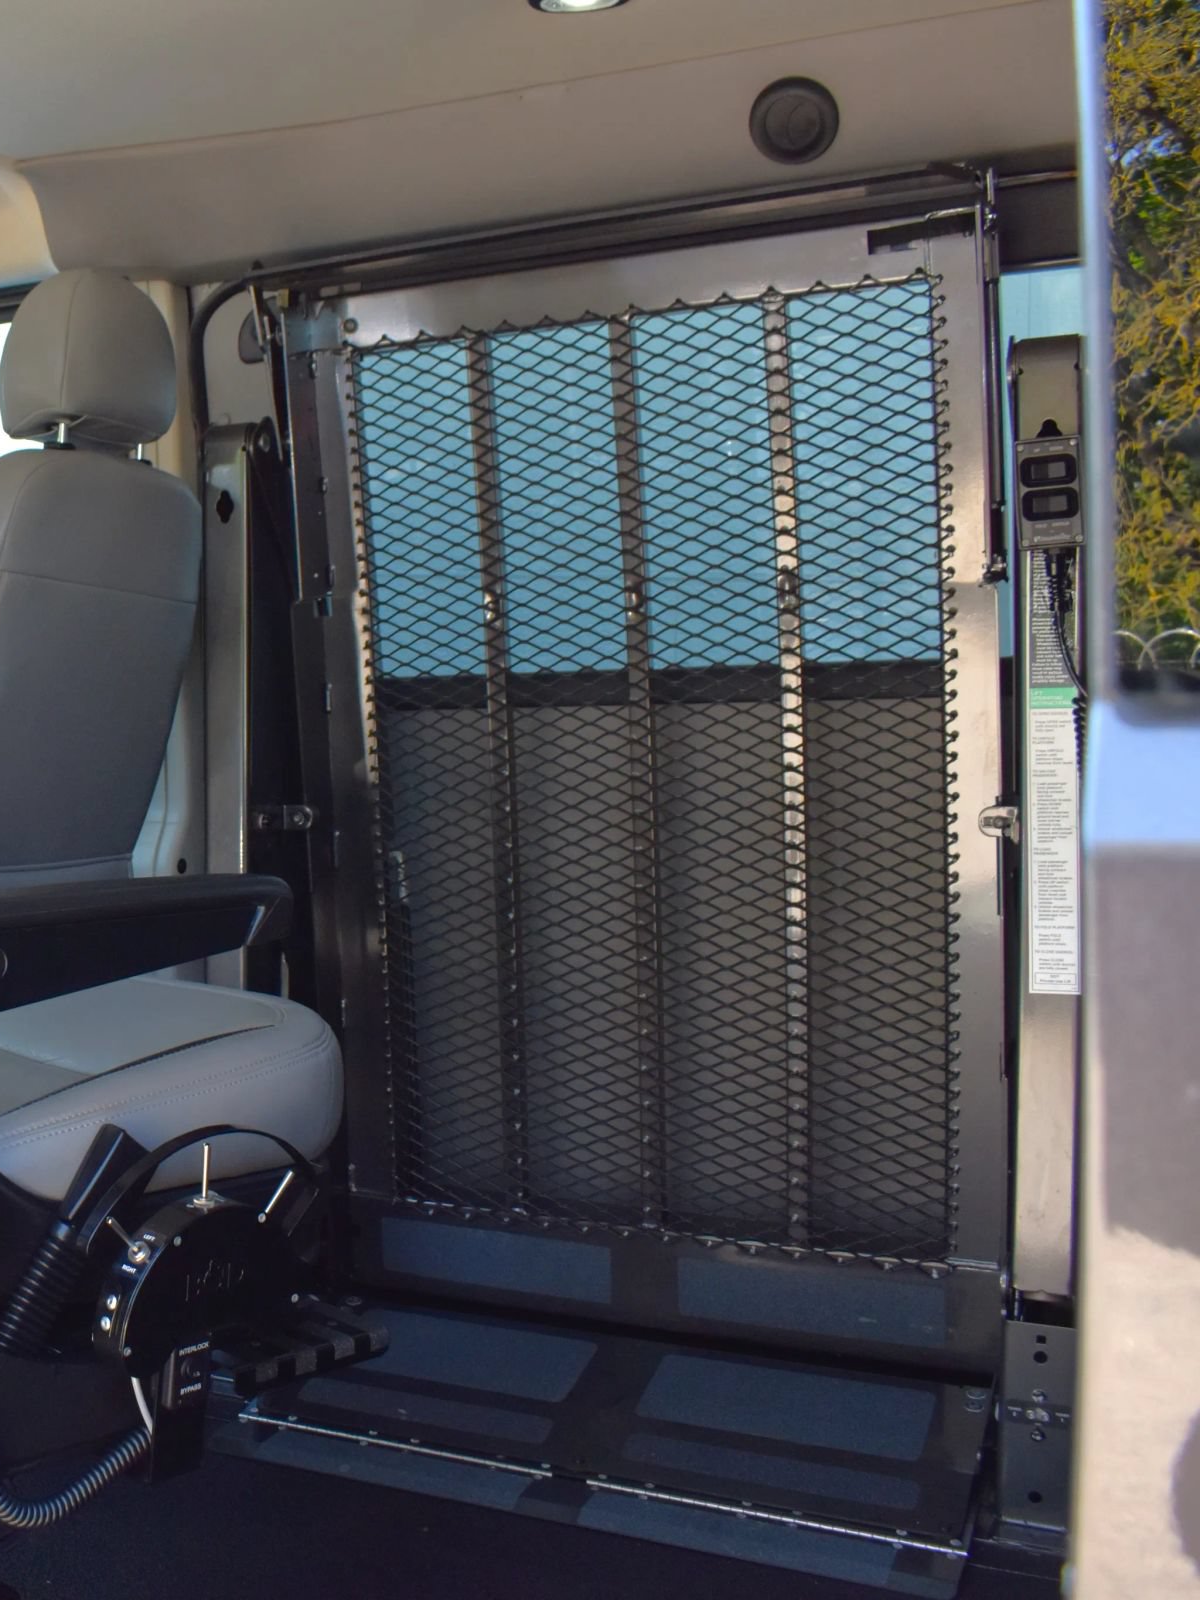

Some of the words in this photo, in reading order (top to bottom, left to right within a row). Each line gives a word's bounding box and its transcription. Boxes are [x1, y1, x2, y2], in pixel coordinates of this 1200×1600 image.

[143, 1233, 156, 1242] LEFT
[121, 1263, 137, 1274] RIGHT
[178, 1340, 209, 1356] INTERLOCK
[179, 1382, 202, 1396] BYPASS
